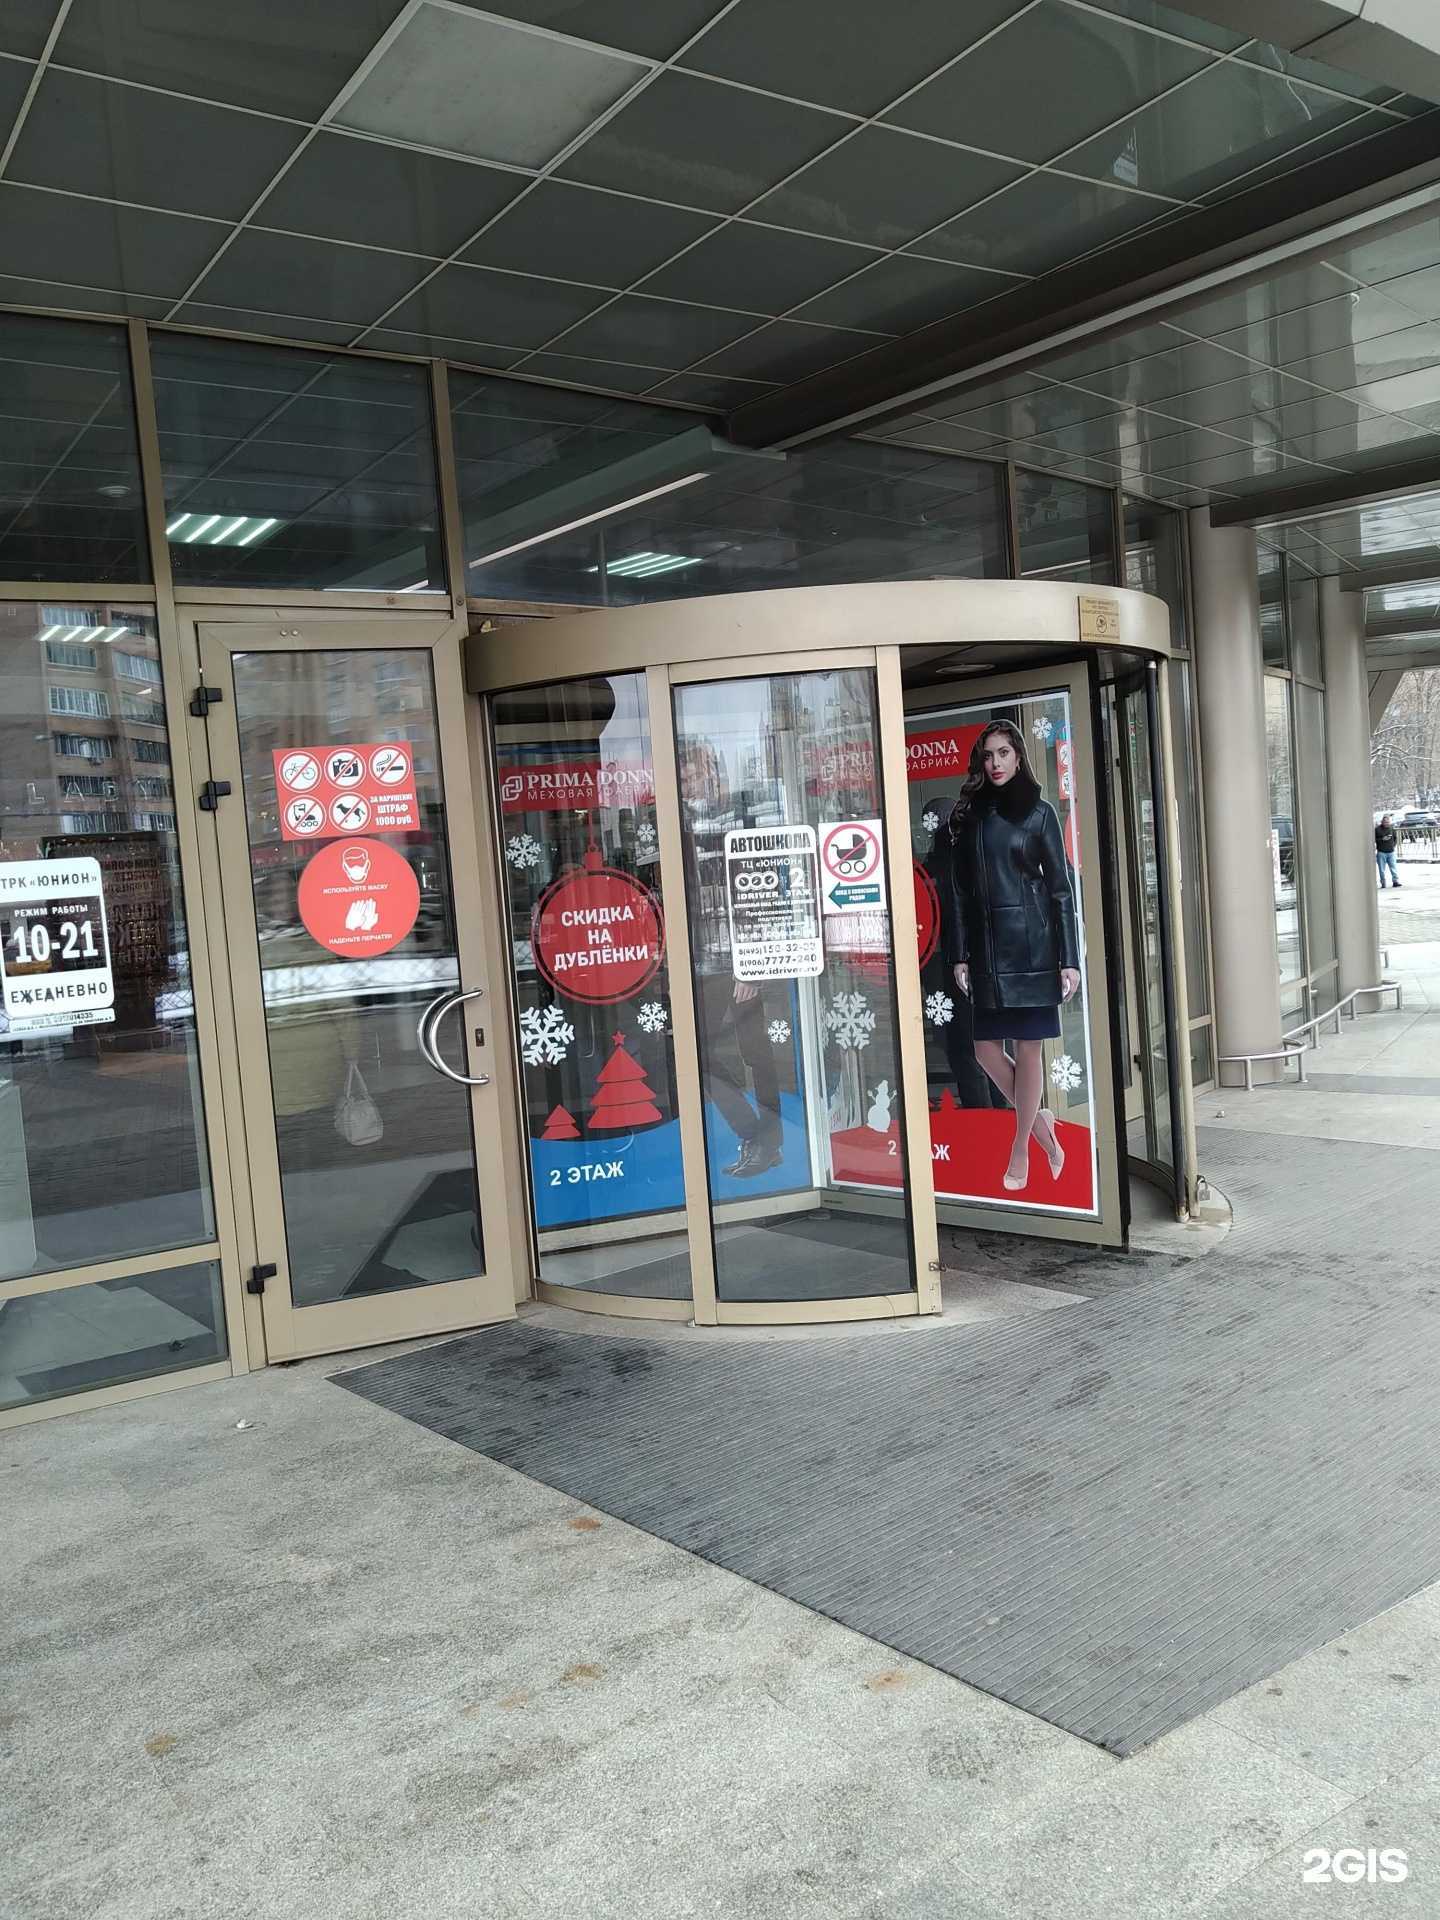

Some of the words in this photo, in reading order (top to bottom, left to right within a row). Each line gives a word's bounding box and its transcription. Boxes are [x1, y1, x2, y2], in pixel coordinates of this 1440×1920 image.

[527, 772, 595, 789] PRIMA
[600, 769, 655, 785] DONN
[527, 788, 593, 801] МЕХОВАЯ
[377, 803, 409, 814] ШТРАФ
[375, 816, 395, 826] 1000
[730, 832, 811, 854] АВТОШКОЛА
[741, 861, 754, 870] ТЦ
[1, 877, 28, 890] ТРК
[30, 872, 97, 887] «ЮНИОН»
[789, 867, 805, 889] 2
[367, 883, 389, 892] МАСКУ
[737, 891, 779, 900] iDRIVER
[785, 888, 811, 898] ЭТАЖ
[14, 907, 48, 918] РЕЖИМ
[52, 904, 89, 915] РАБОТЫ
[561, 905, 634, 927] СКИДКА
[13, 920, 99, 964] 10-21
[588, 928, 612, 945] НА
[554, 944, 649, 972] ДУБЛЁНКИ
[11, 981, 108, 1004] ЕЖЕДНЕВНО
[887, 1140, 897, 1156] 2
[549, 1169, 562, 1187] 2
[567, 1160, 624, 1184] ЭТАЖ
